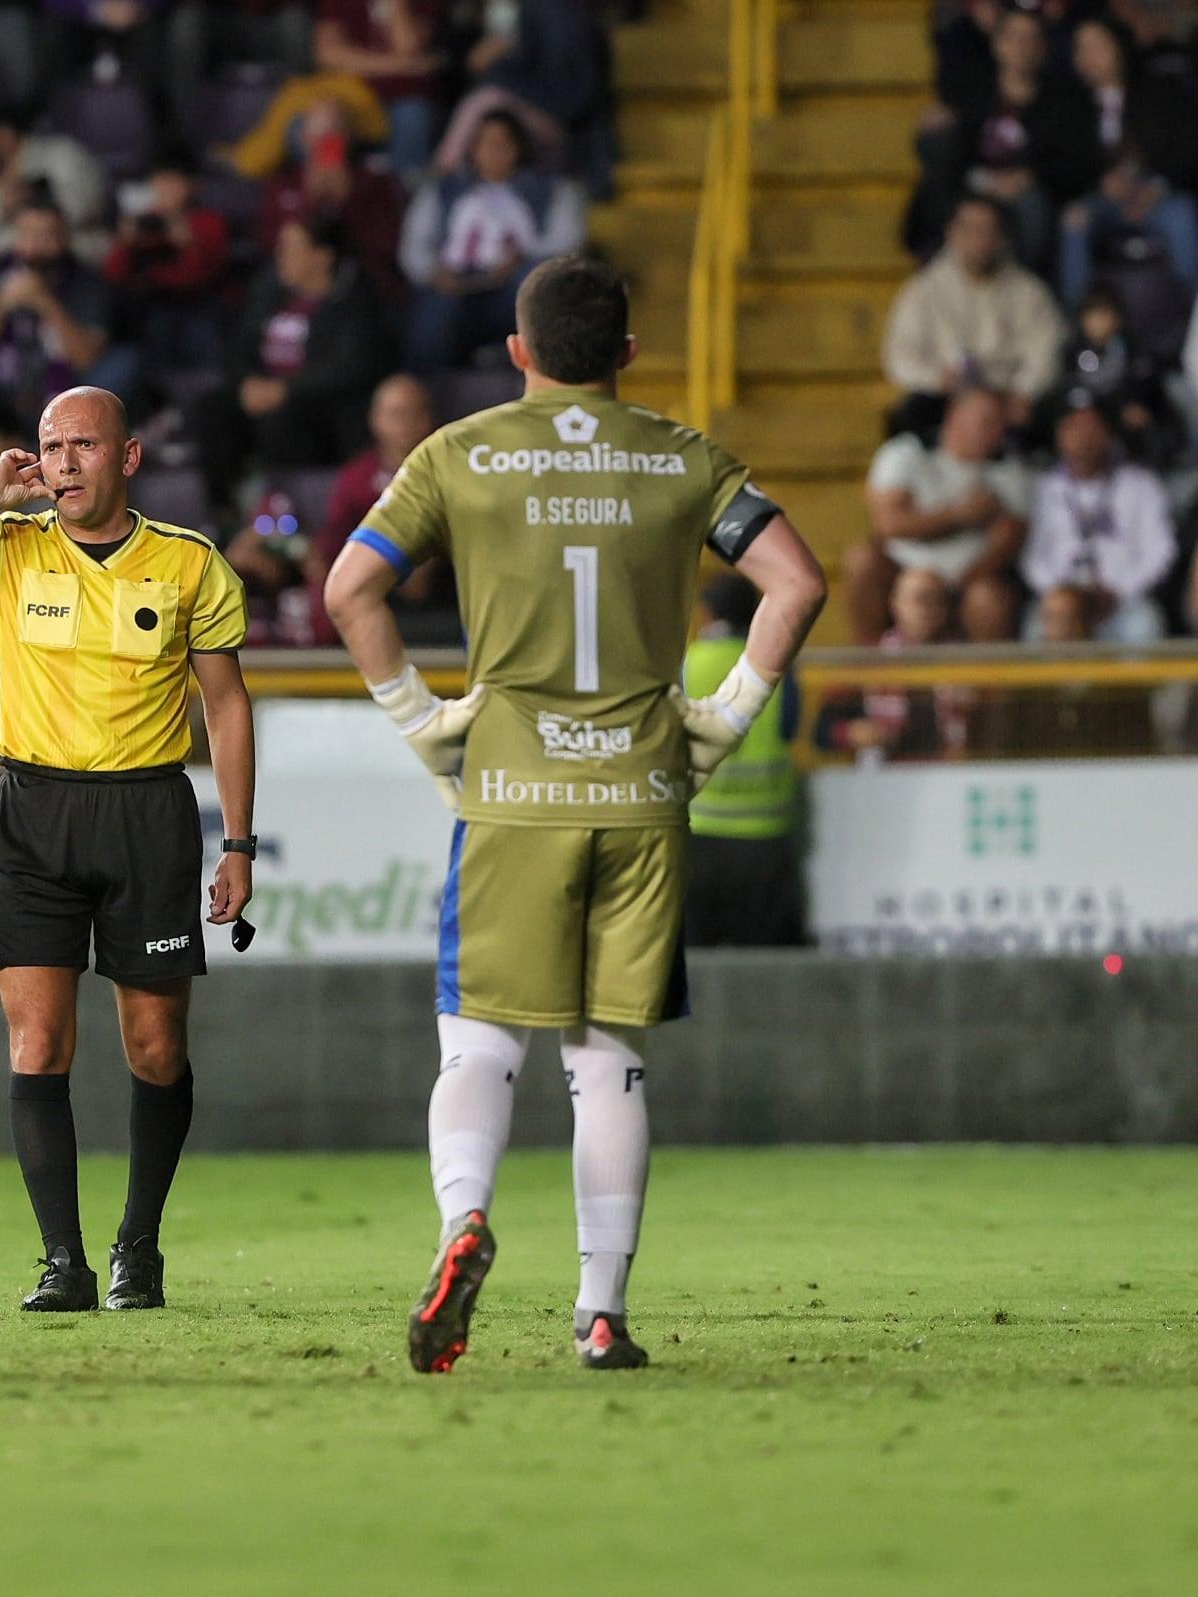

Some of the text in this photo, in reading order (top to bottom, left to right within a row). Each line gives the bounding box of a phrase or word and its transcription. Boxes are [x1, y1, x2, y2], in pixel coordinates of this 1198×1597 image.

[468, 443, 687, 477] Coopealianza
[525, 496, 633, 526] B.SEGURA
[26, 603, 71, 618] FCRF
[563, 545, 599, 692] 1
[481, 768, 582, 804] HOTEL
[588, 782, 646, 804] DEL
[145, 935, 191, 954] FCRF
